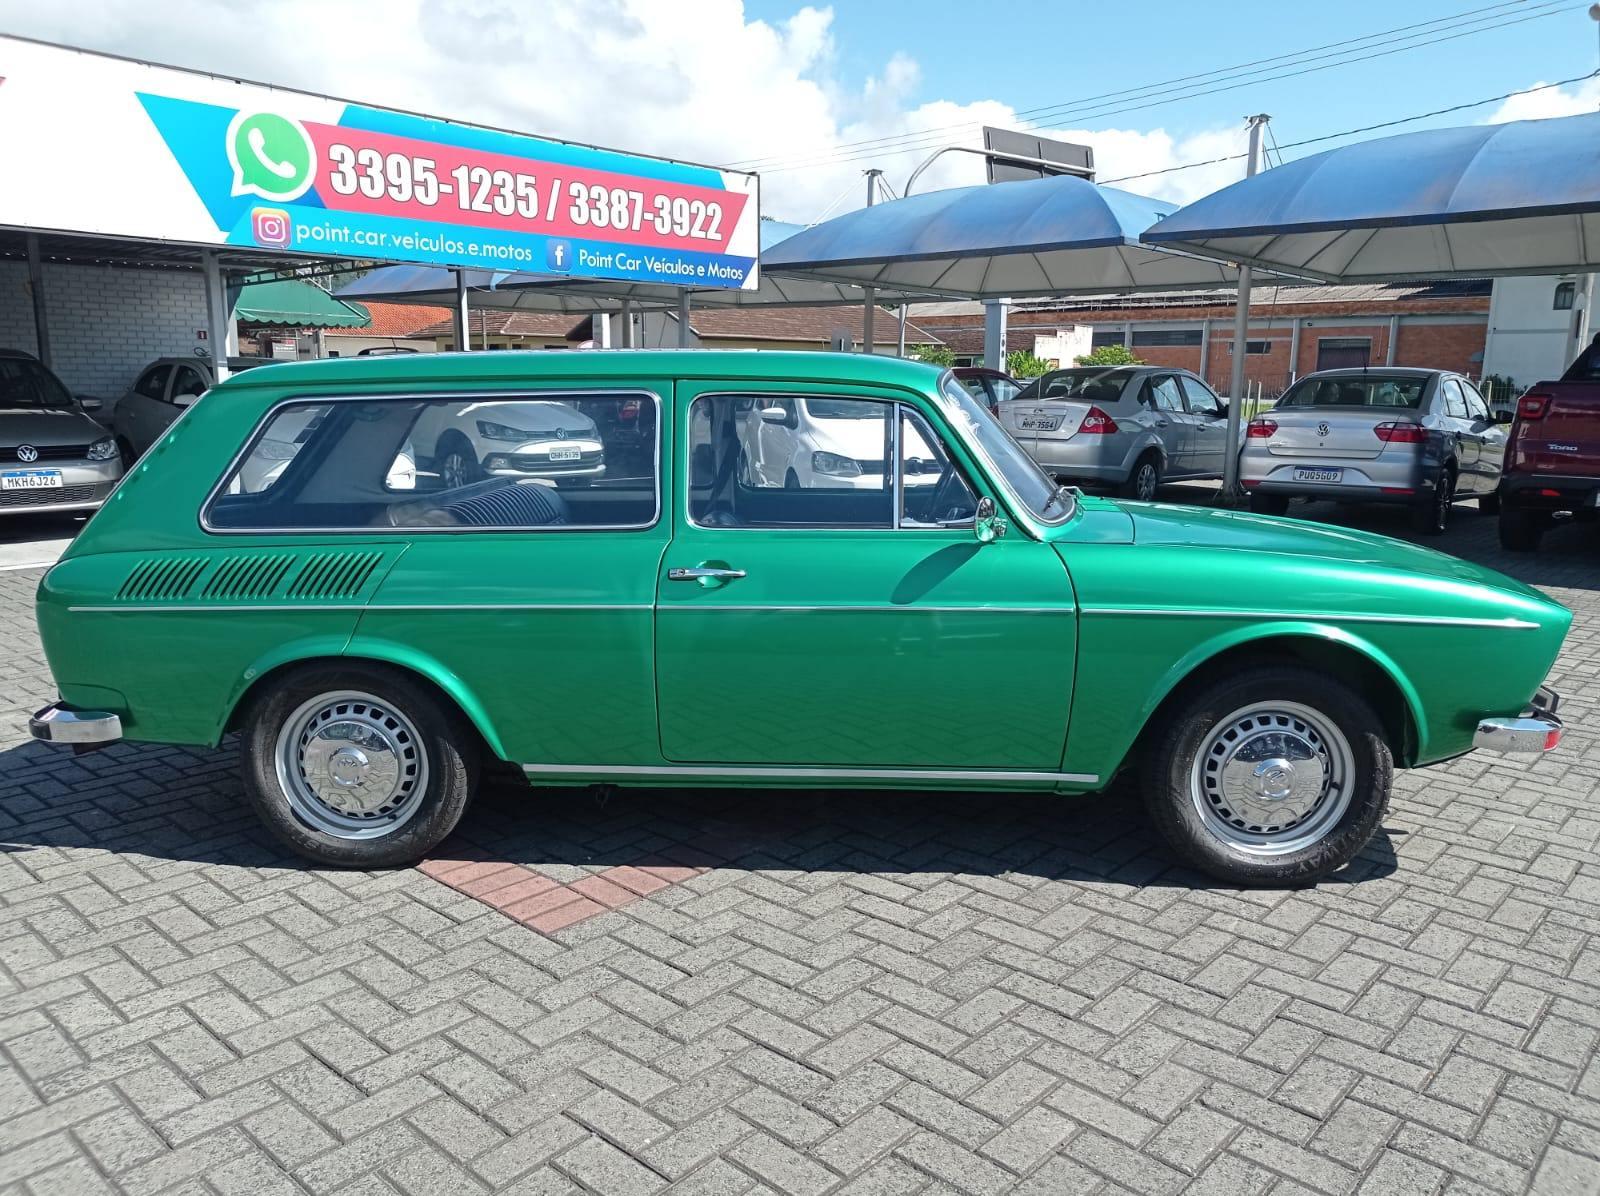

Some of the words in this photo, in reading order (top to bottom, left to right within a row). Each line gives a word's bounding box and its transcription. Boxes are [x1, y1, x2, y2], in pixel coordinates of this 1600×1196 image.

[328, 143, 539, 219] 3395-1235
[545, 178, 562, 222] /
[568, 181, 723, 241] 3387-3922
[296, 222, 532, 261] point.car.veiculos.e.motos
[579, 249, 612, 269] Point
[615, 253, 640, 271] Car
[644, 255, 694, 276] Veículos
[697, 265, 705, 276] e
[707, 262, 743, 280] Motos
[7, 477, 56, 488] MKH6J26
